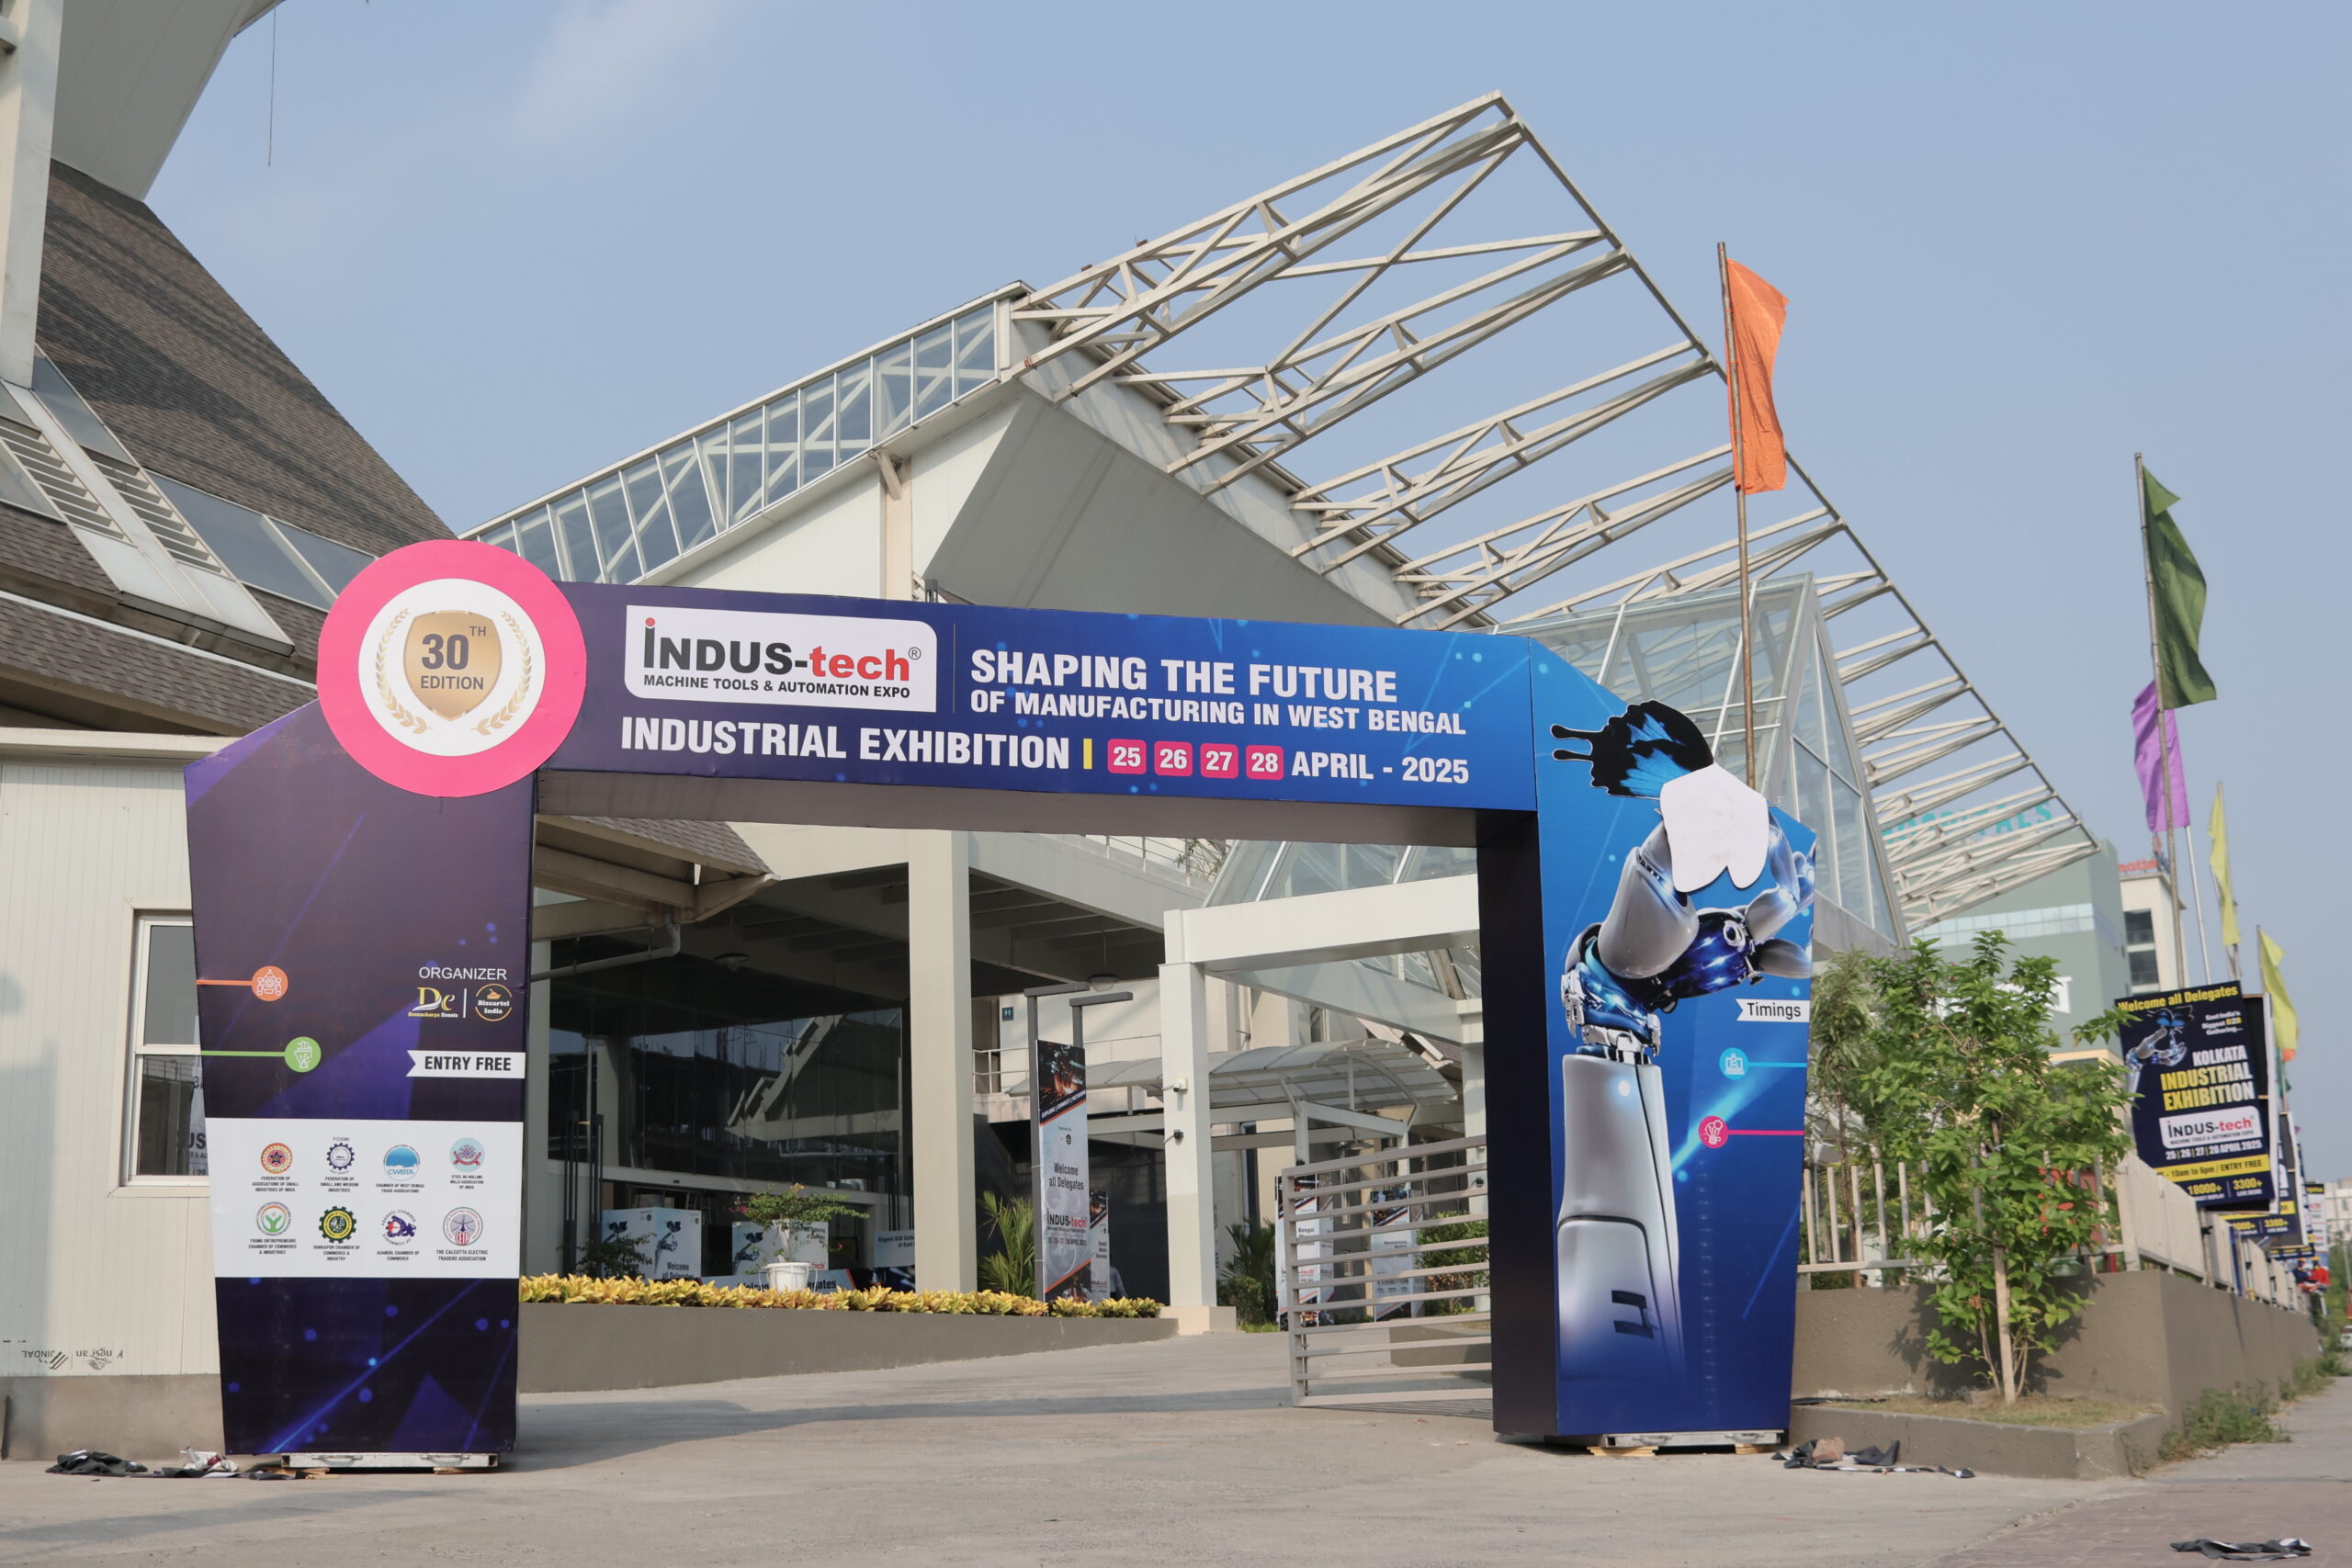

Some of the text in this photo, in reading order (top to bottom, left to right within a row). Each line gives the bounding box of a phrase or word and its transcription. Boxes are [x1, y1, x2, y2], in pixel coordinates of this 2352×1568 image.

[421, 626, 487, 670] 30 TH
[420, 675, 484, 691] EDITION
[971, 649, 1397, 704] SHAPING THE FUTURE
[643, 674, 910, 699] MACHINE TOOLS & AUTOMATION EXPO
[970, 689, 1467, 736] OF MANUFACTURING IN WEST BENGAL
[621, 716, 847, 761] INDUSTRIAL
[858, 728, 1070, 771] EXHIBITION
[1112, 746, 1142, 768] 25
[1159, 747, 1188, 770] 26
[1204, 750, 1233, 772] 27
[1250, 751, 1280, 773] 28
[1291, 750, 1374, 780] APRIL
[1401, 756, 1470, 784] 2025
[418, 966, 507, 981] ORGANIZER
[2118, 987, 2239, 1012] Welcome all Delegates
[1747, 1002, 1802, 1020] Timings
[424, 1055, 512, 1072] ENTRY FREE
[2192, 1045, 2248, 1067] KOLKATA
[2160, 1062, 2253, 1091] INDUSTRIAL
[2163, 1080, 2256, 1111] EXHIBITION
[2165, 1150, 2177, 1160] 25
[2179, 1148, 2191, 1158] 26
[2194, 1146, 2205, 1156] 27
[2220, 1142, 2241, 1154] APRIL
[1053, 1162, 1079, 1176] Welcome
[2171, 1168, 2190, 1178] 10am
[2220, 1162, 2242, 1171] ENTRY
[2245, 1159, 2262, 1168] FREE
[1048, 1177, 1084, 1191] all Delegates
[2233, 1178, 2263, 1190] 3300+
[667, 1262, 690, 1271] Welcome
[21, 1350, 55, 1359] JINDAL
